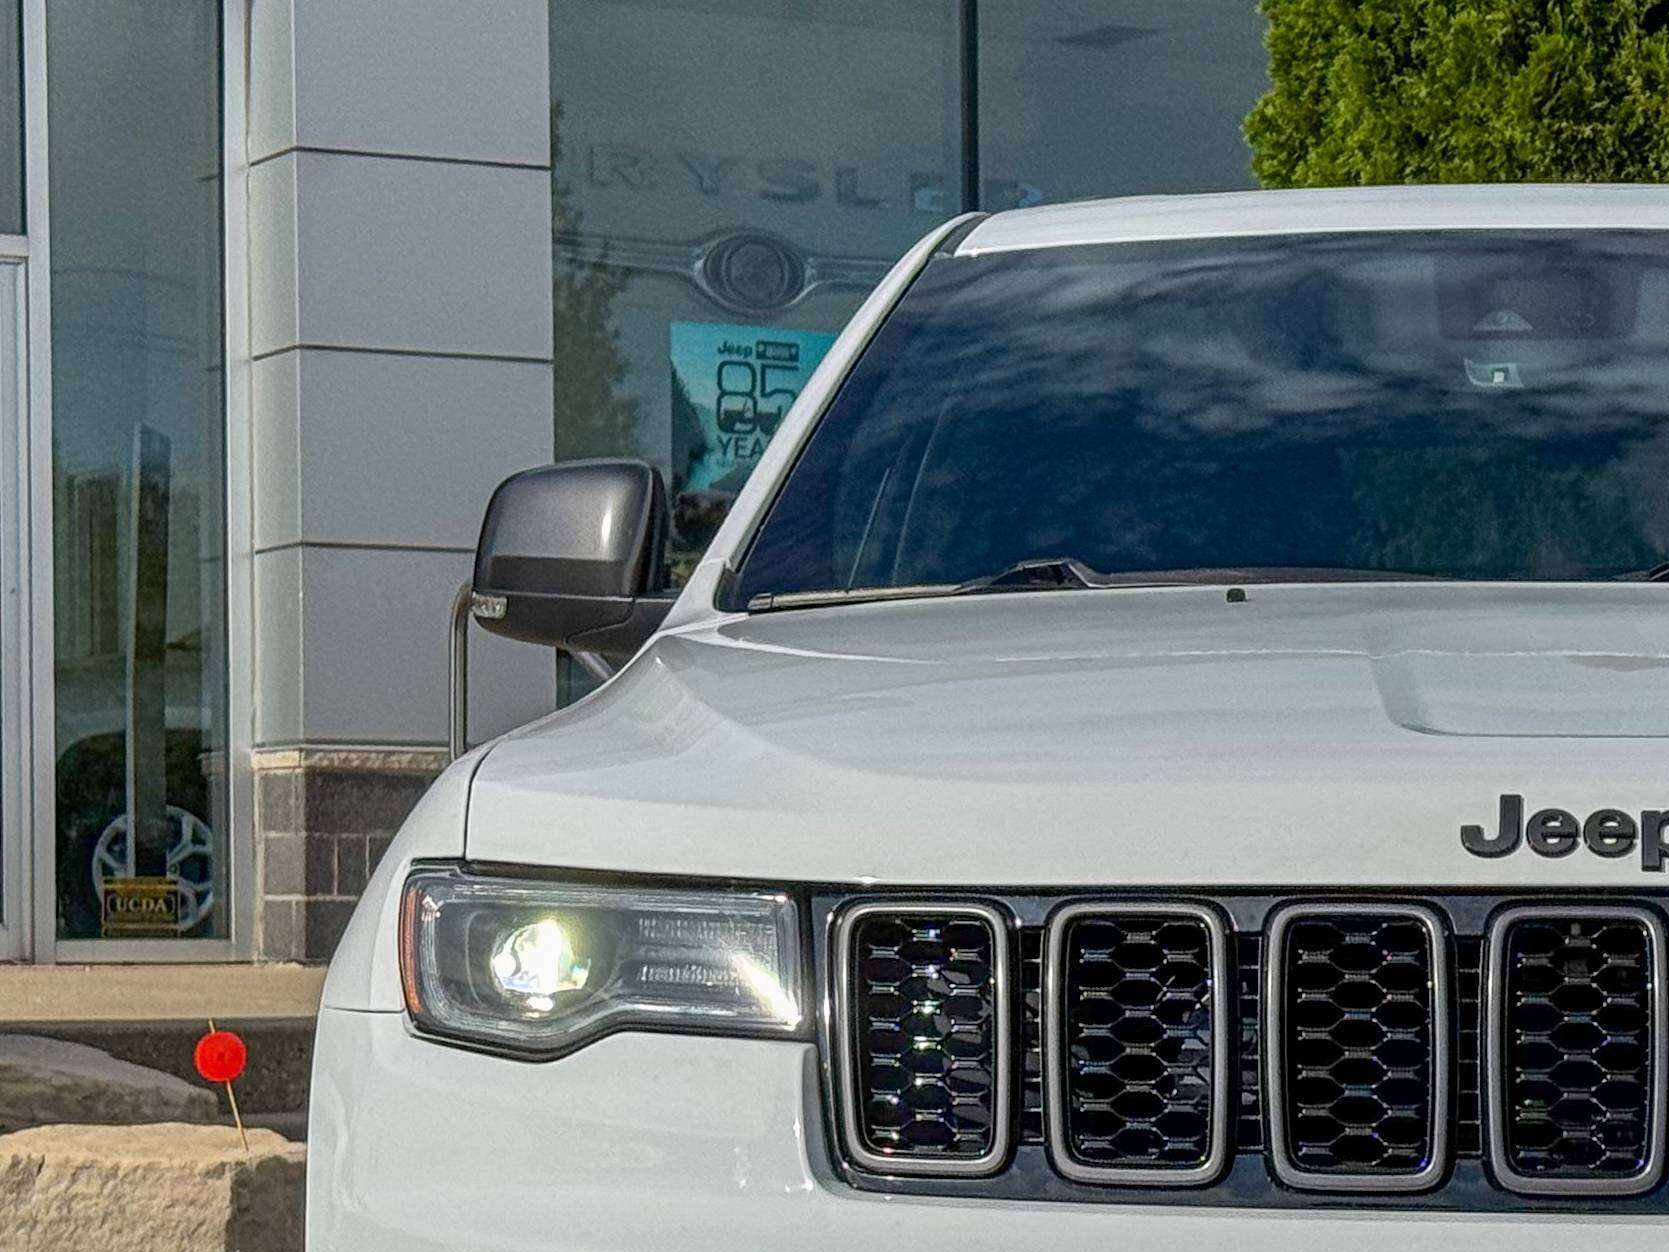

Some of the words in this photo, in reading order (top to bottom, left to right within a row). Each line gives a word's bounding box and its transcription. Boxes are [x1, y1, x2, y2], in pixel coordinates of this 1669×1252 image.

[717, 341, 753, 359] Jeep
[716, 360, 800, 435] 85
[716, 435, 772, 458] YEA
[115, 896, 168, 913] UCDA
